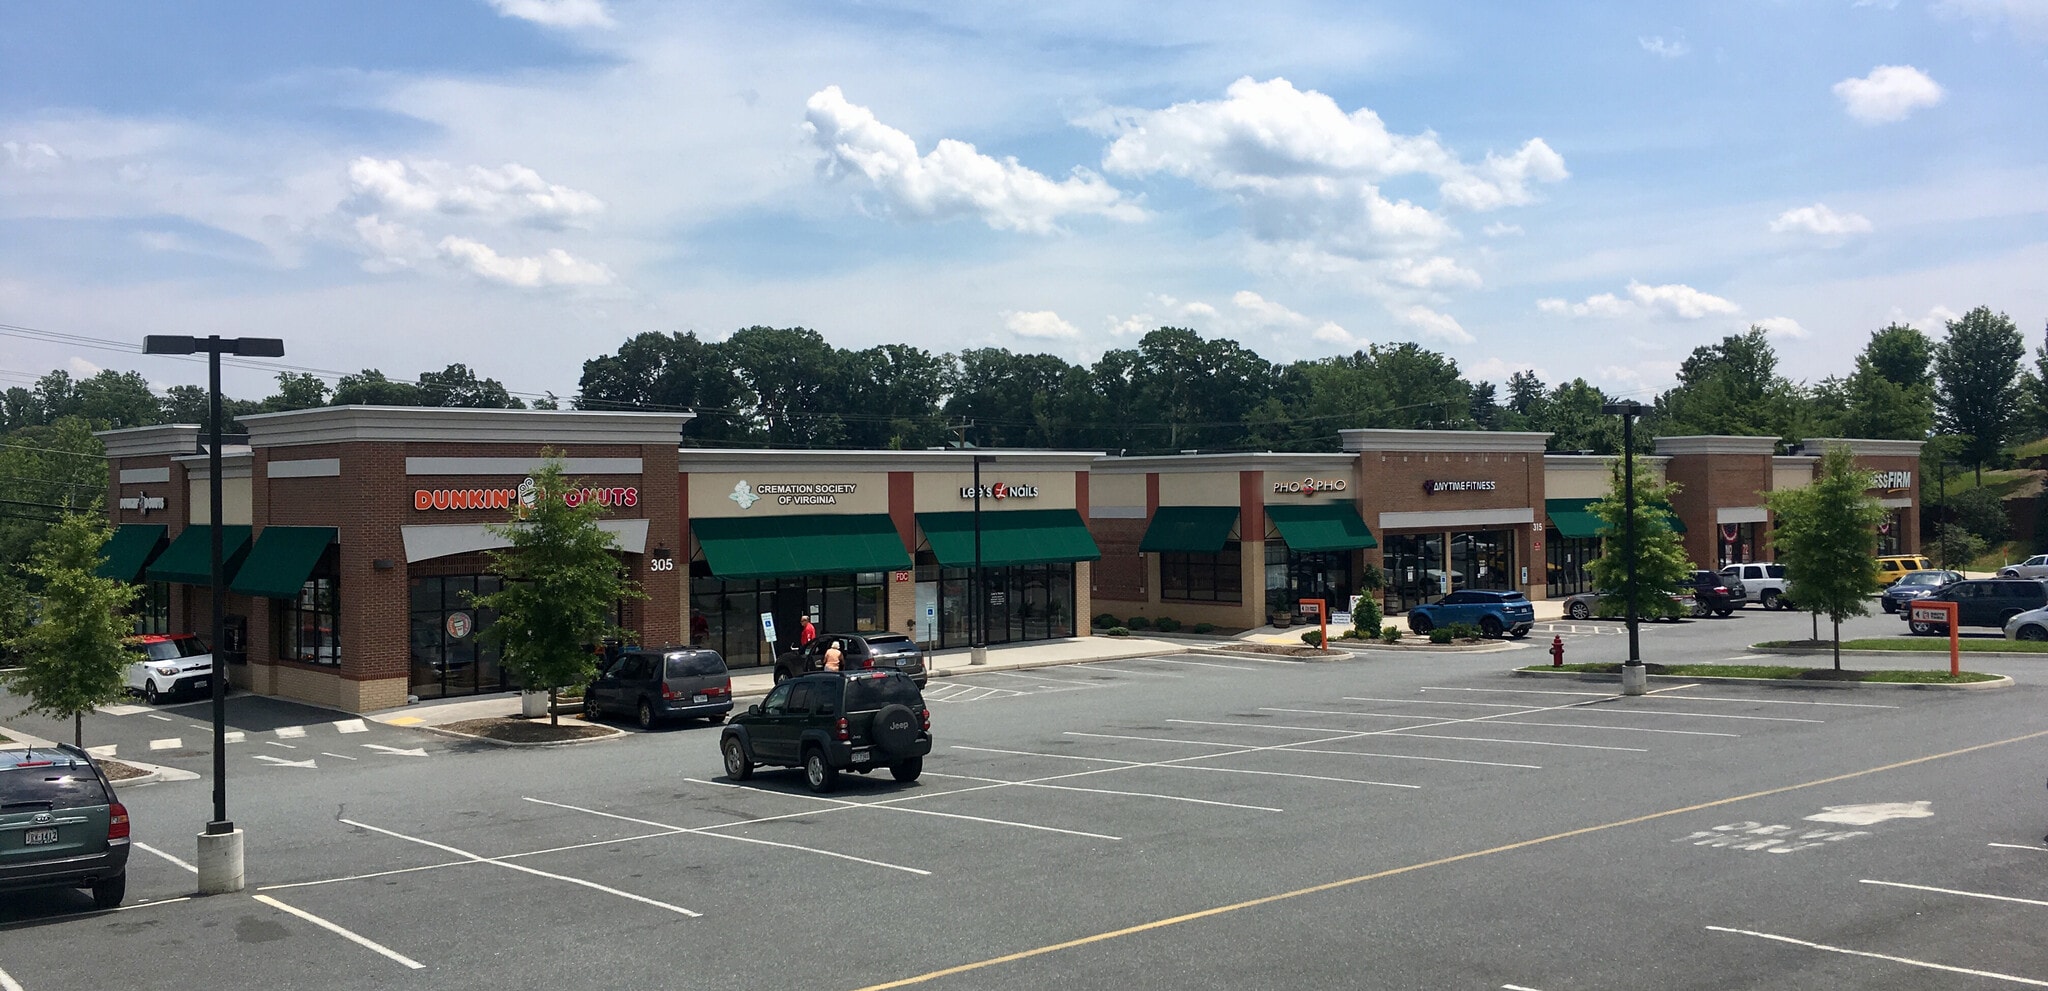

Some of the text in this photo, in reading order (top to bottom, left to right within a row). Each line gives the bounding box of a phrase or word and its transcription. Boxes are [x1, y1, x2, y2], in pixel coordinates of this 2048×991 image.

[1888, 471, 1911, 488] FIRM
[757, 484, 857, 494] CREMATION SOCIETY
[1273, 481, 1300, 493] PHO
[1316, 479, 1346, 491] PHO
[1433, 481, 1496, 491] ANYTIME FITNESS
[414, 489, 516, 510] DUNKIN'
[778, 495, 836, 505] OF VIRGINIA
[1532, 522, 1542, 531] 315
[651, 558, 673, 571] 305
[896, 572, 908, 581] FDC
[889, 722, 909, 730] Jeep
